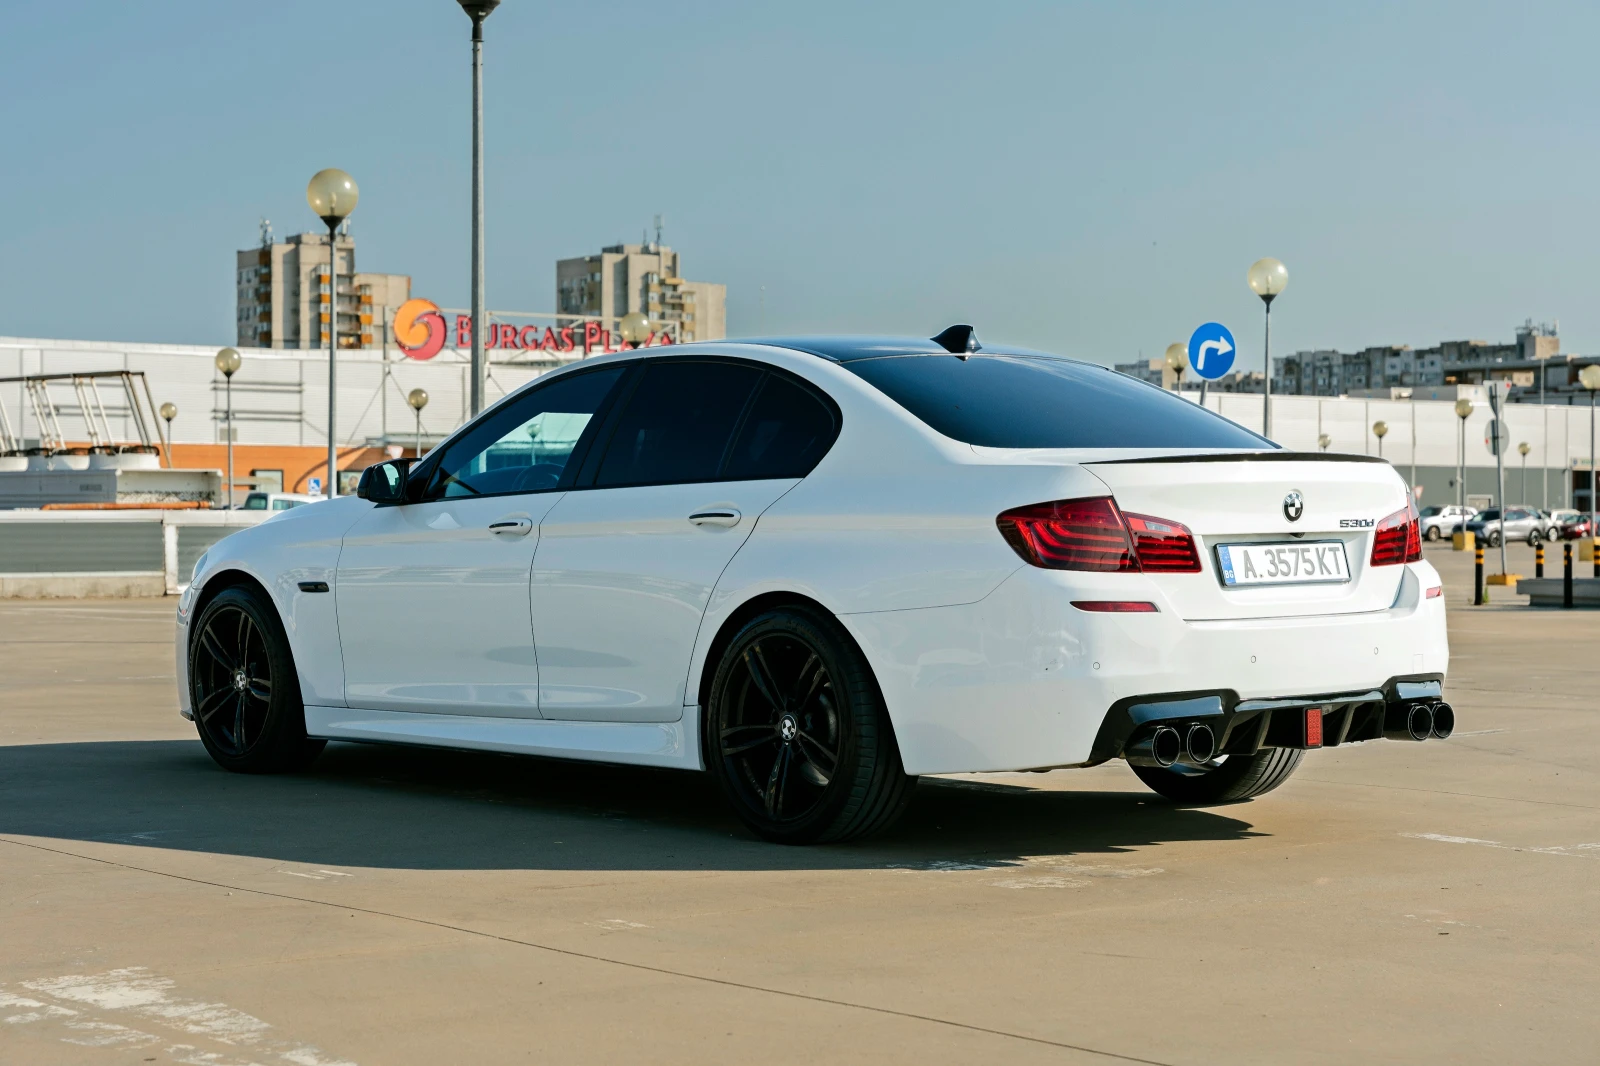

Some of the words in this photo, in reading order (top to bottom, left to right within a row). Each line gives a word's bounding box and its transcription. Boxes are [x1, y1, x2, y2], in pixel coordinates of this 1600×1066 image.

[456, 315, 574, 352] BURGAS
[1339, 518, 1375, 528] 530d
[1224, 570, 1234, 579] BG
